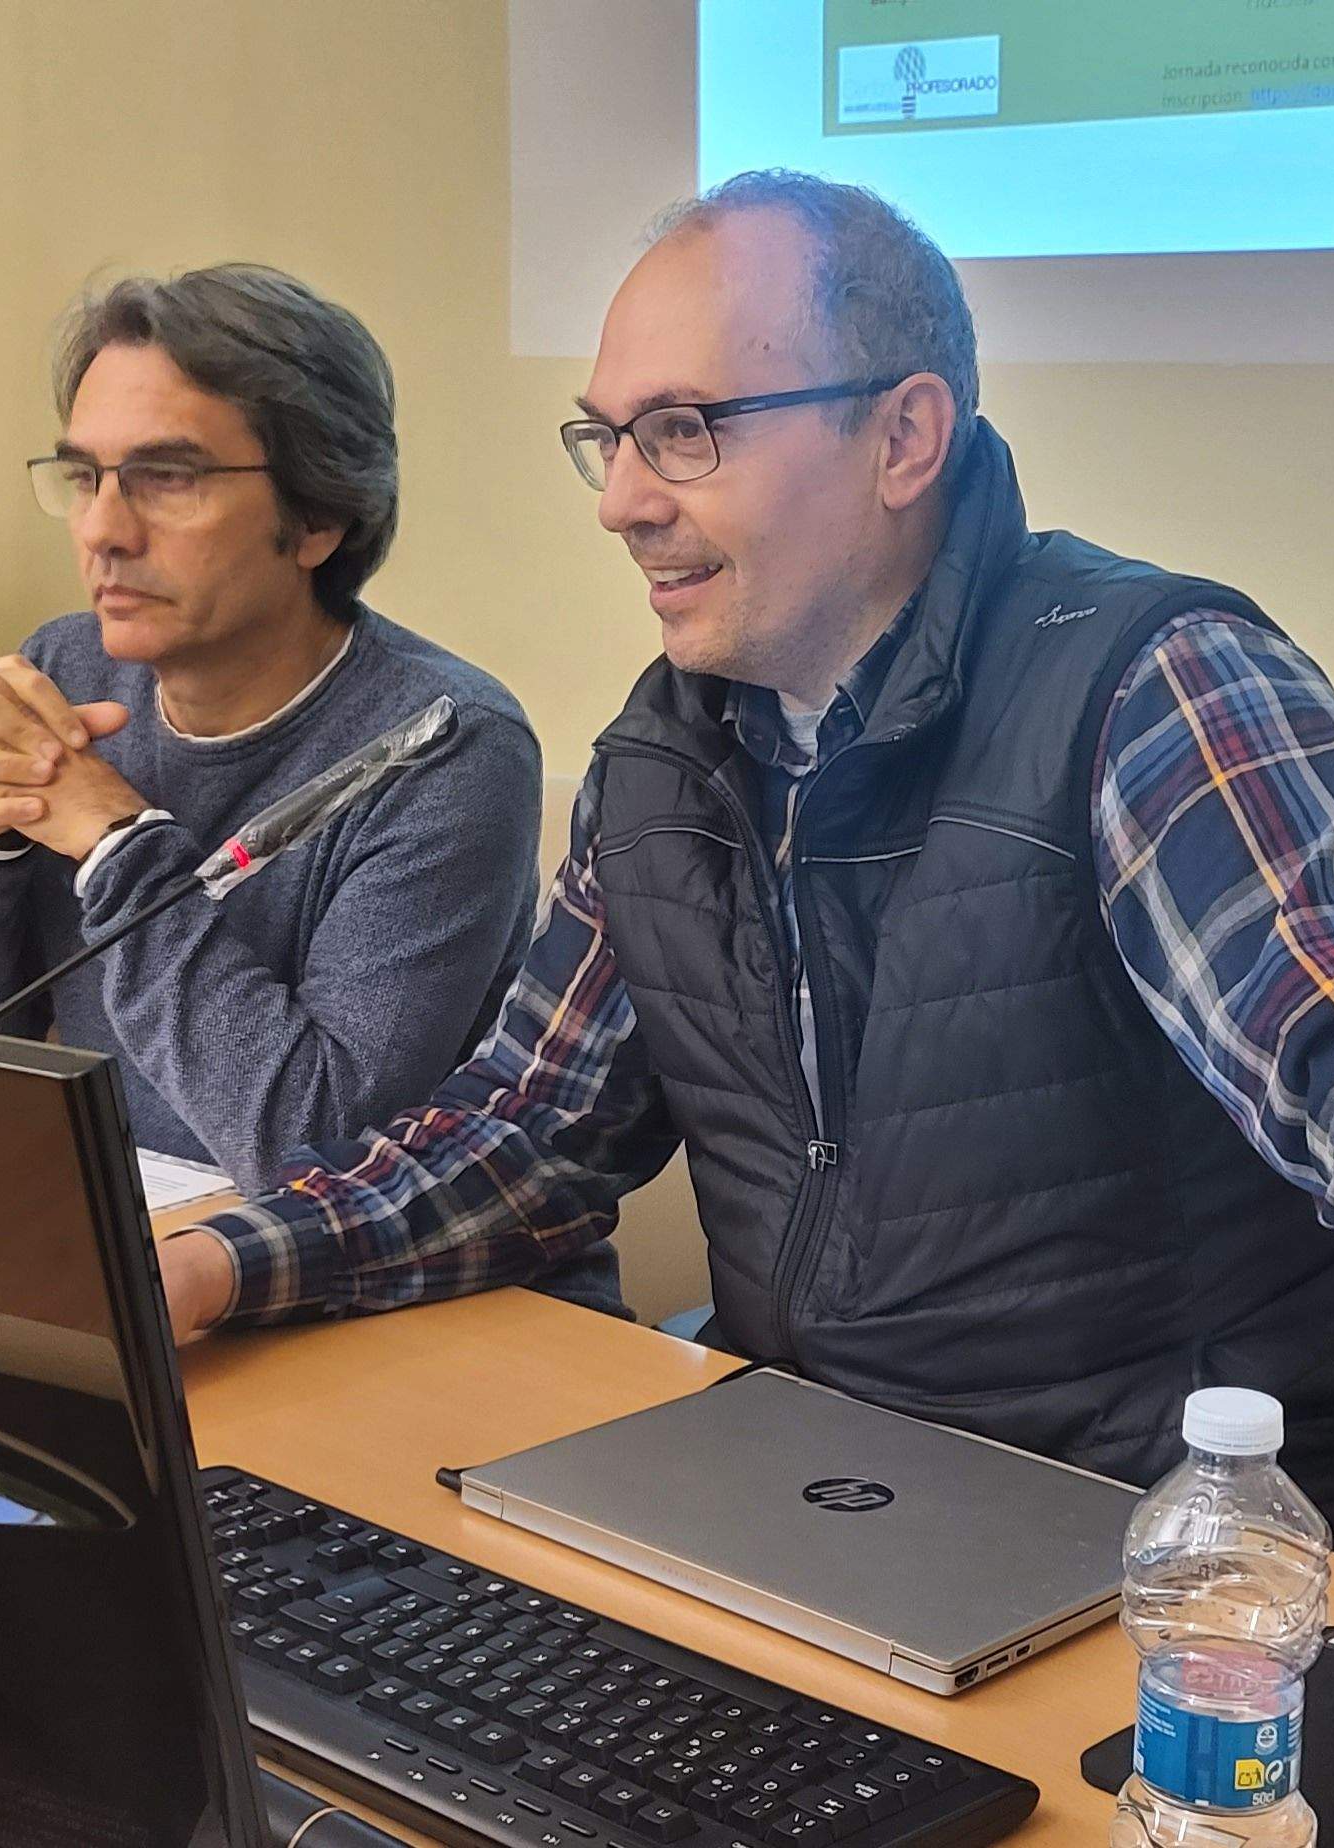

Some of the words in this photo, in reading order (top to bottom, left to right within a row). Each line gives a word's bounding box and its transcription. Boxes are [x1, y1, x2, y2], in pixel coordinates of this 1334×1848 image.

[1162, 61, 1222, 81] Jornada
[1225, 54, 1310, 76] reconocida
[906, 76, 997, 94] PROFESORADO
[804, 1478, 893, 1511] hp
